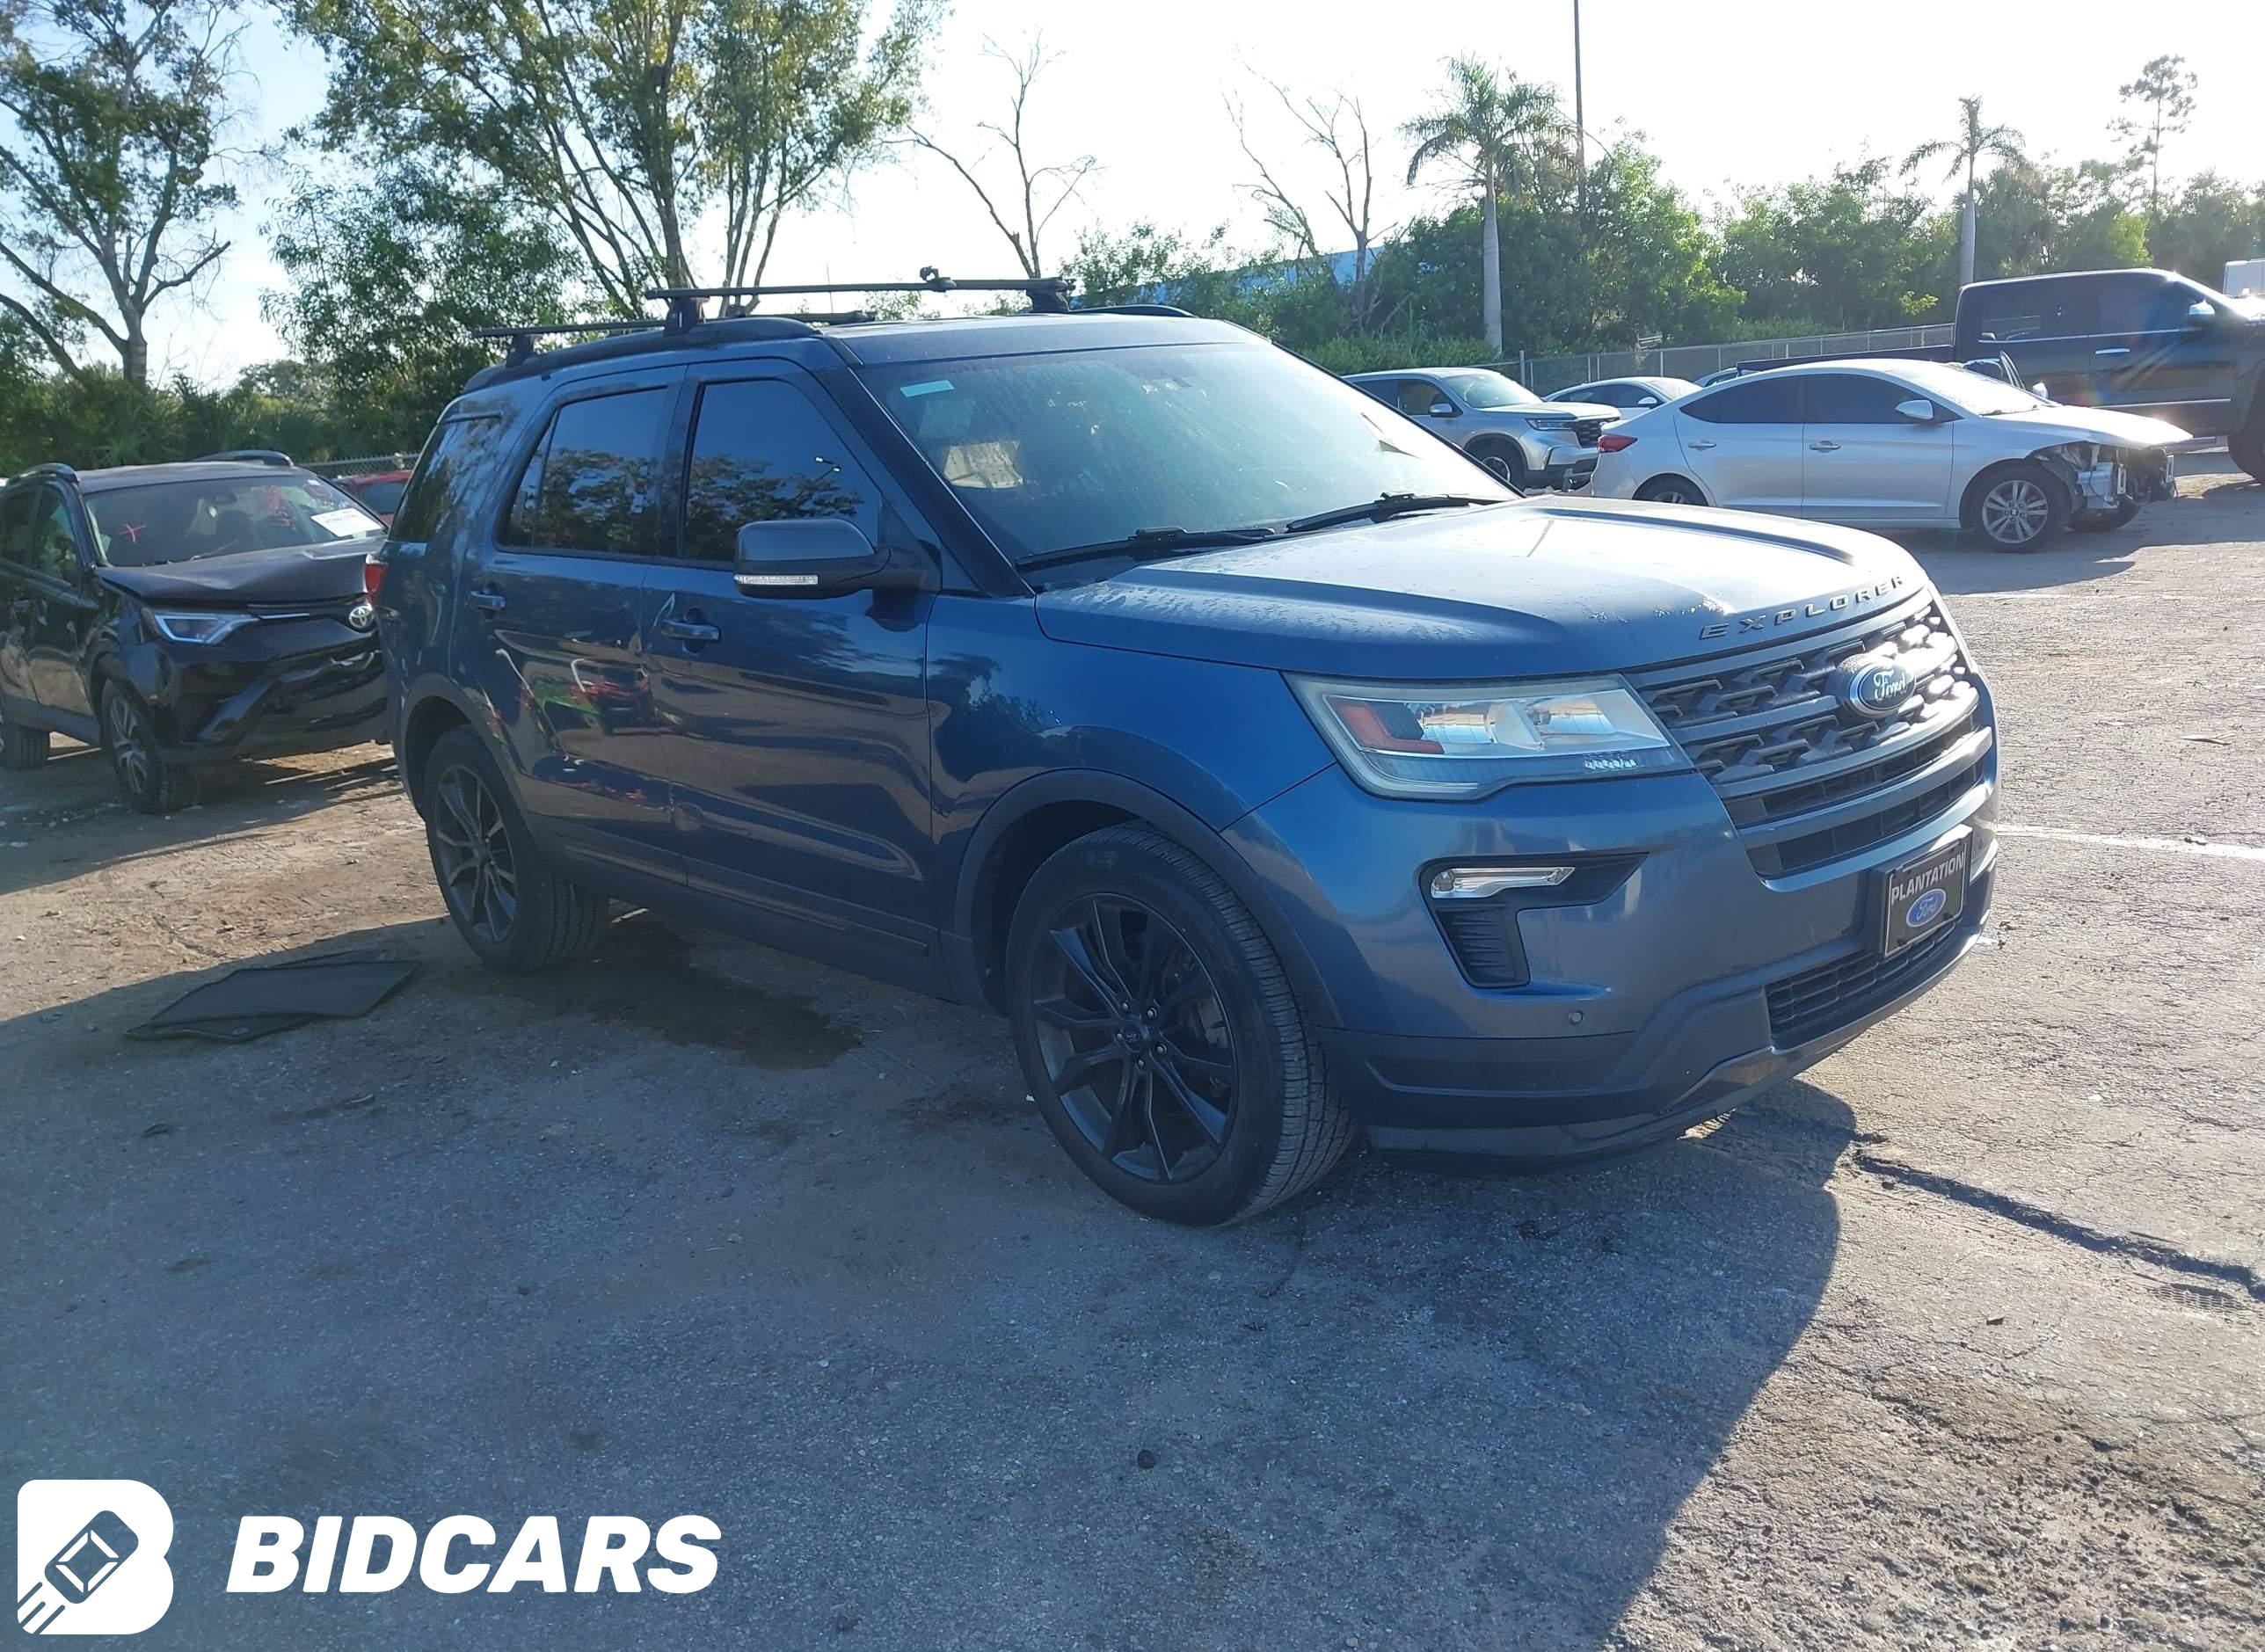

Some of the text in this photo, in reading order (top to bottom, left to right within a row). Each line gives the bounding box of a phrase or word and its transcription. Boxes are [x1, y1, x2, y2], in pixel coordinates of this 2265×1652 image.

[1699, 576, 1904, 640] EXPLORER
[1873, 668, 1907, 702] Ford
[1891, 852, 1964, 906] PLANTATION
